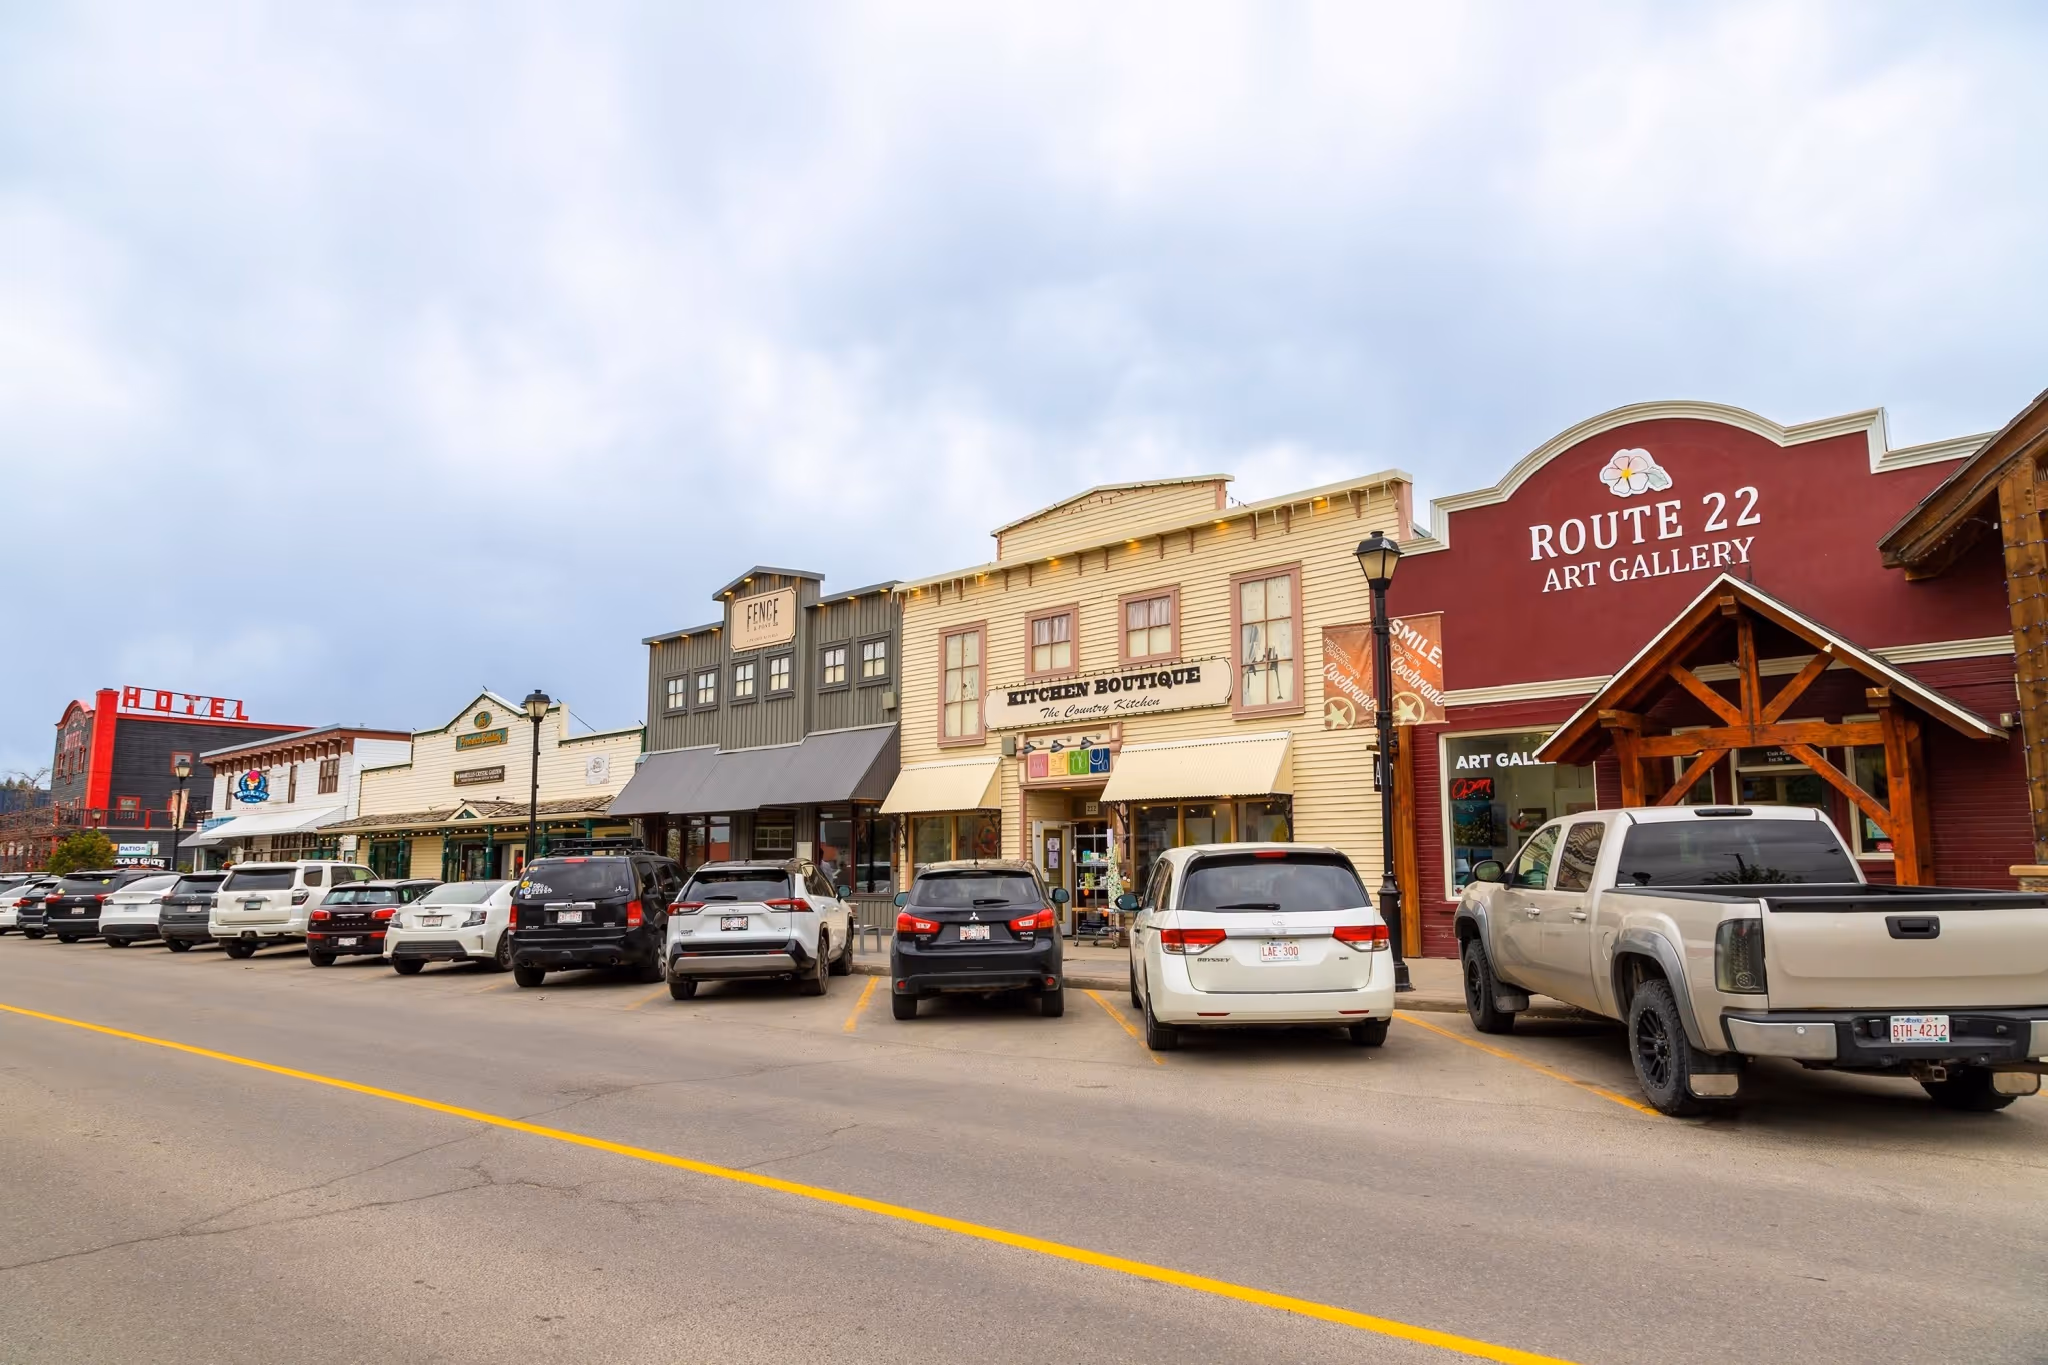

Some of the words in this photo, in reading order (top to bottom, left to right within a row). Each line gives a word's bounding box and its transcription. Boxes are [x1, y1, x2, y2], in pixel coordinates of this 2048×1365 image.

[1528, 500, 1683, 562] ROUTE
[1702, 486, 1761, 533] 22
[1542, 562, 1601, 593] ART
[1609, 536, 1755, 582] GALLERY
[747, 598, 778, 633] FENCE
[1324, 637, 1352, 662] HISTORIC
[1389, 618, 1443, 669] SMILE.
[1391, 641, 1414, 663] YOU'RE
[1413, 658, 1422, 668] IN
[1324, 646, 1361, 680] DOWNTOWN
[1007, 681, 1090, 706] KITCHEN
[1094, 666, 1201, 696] BOUTIQUE
[1323, 662, 1377, 711] Cochrane
[1390, 656, 1445, 707] Cochrane
[122, 685, 249, 721] HOTEL
[1040, 707, 1060, 719] The
[1064, 703, 1110, 718] Country
[1113, 697, 1161, 711] Kitchen
[1455, 754, 1491, 769] ART
[1496, 752, 1557, 767] GAL
[1893, 1024, 1947, 1037] BTH-4212
